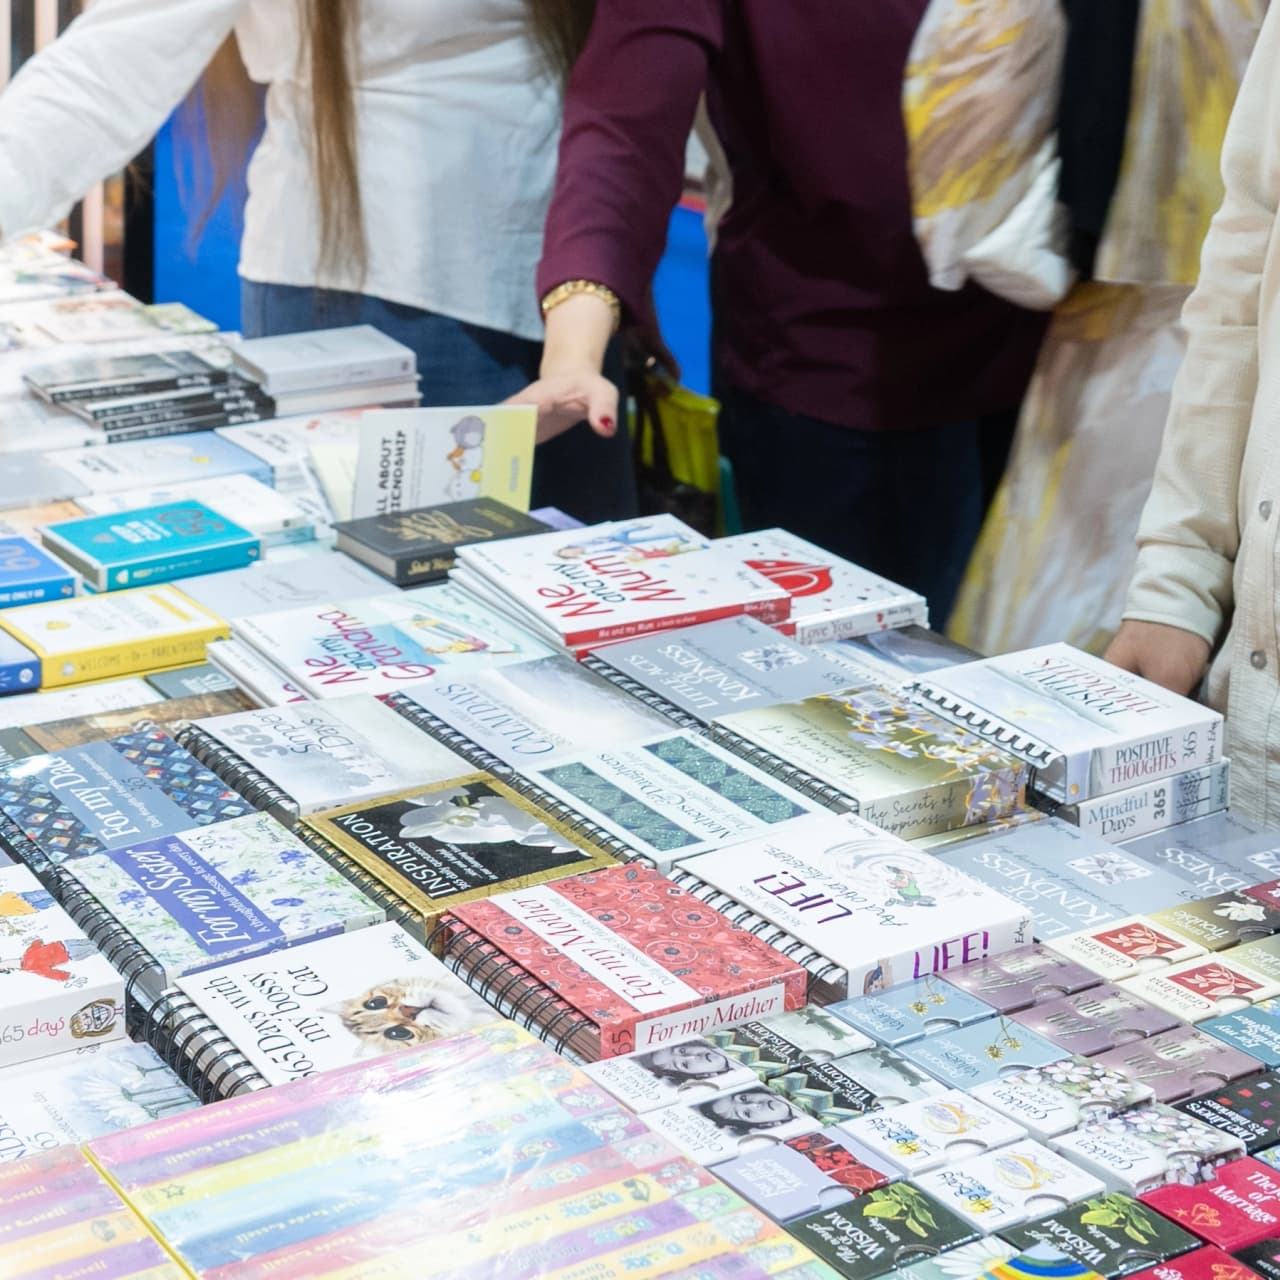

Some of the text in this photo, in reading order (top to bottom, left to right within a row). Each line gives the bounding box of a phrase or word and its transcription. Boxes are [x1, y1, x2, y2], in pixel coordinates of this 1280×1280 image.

[585, 555, 686, 601] Mum
[537, 584, 615, 618] Me
[304, 655, 369, 685] Me
[657, 644, 762, 703] KINDNESS
[1033, 658, 1161, 714] THOUGHTS
[1022, 669, 1129, 716] POSITIVE
[222, 724, 289, 758] 365
[252, 713, 323, 755] Simpler
[301, 716, 354, 749] Days
[1115, 735, 1174, 765] POSITIVE
[1182, 730, 1198, 760] 365
[1110, 751, 1177, 785] THOUGHTS
[863, 787, 955, 820] The Secrets of
[1088, 792, 1149, 825] Mindful
[1153, 787, 1166, 821] 365
[1101, 814, 1137, 836] Days
[337, 813, 459, 899] INSPIRATION
[125, 848, 253, 946] For my Sister
[753, 870, 853, 925] LIFE!
[972, 852, 1114, 925] KINDNESS
[512, 896, 665, 1001] For my Mother
[913, 930, 990, 980] LIFE!
[287, 964, 329, 998] Cat
[242, 970, 332, 1044] my bossy
[647, 994, 779, 1045] For my Mother
[27, 1015, 66, 1043] days
[745, 1020, 797, 1058] Wisdom
[819, 1062, 871, 1105] Wisdom
[1185, 1102, 1257, 1143] One Liners
[1246, 1171, 1272, 1192] The
[1248, 1188, 1270, 1203] of
[1209, 1184, 1278, 1225] Marriage
[822, 1211, 888, 1261] WISDOM
[1039, 1219, 1108, 1266] WISDOM
